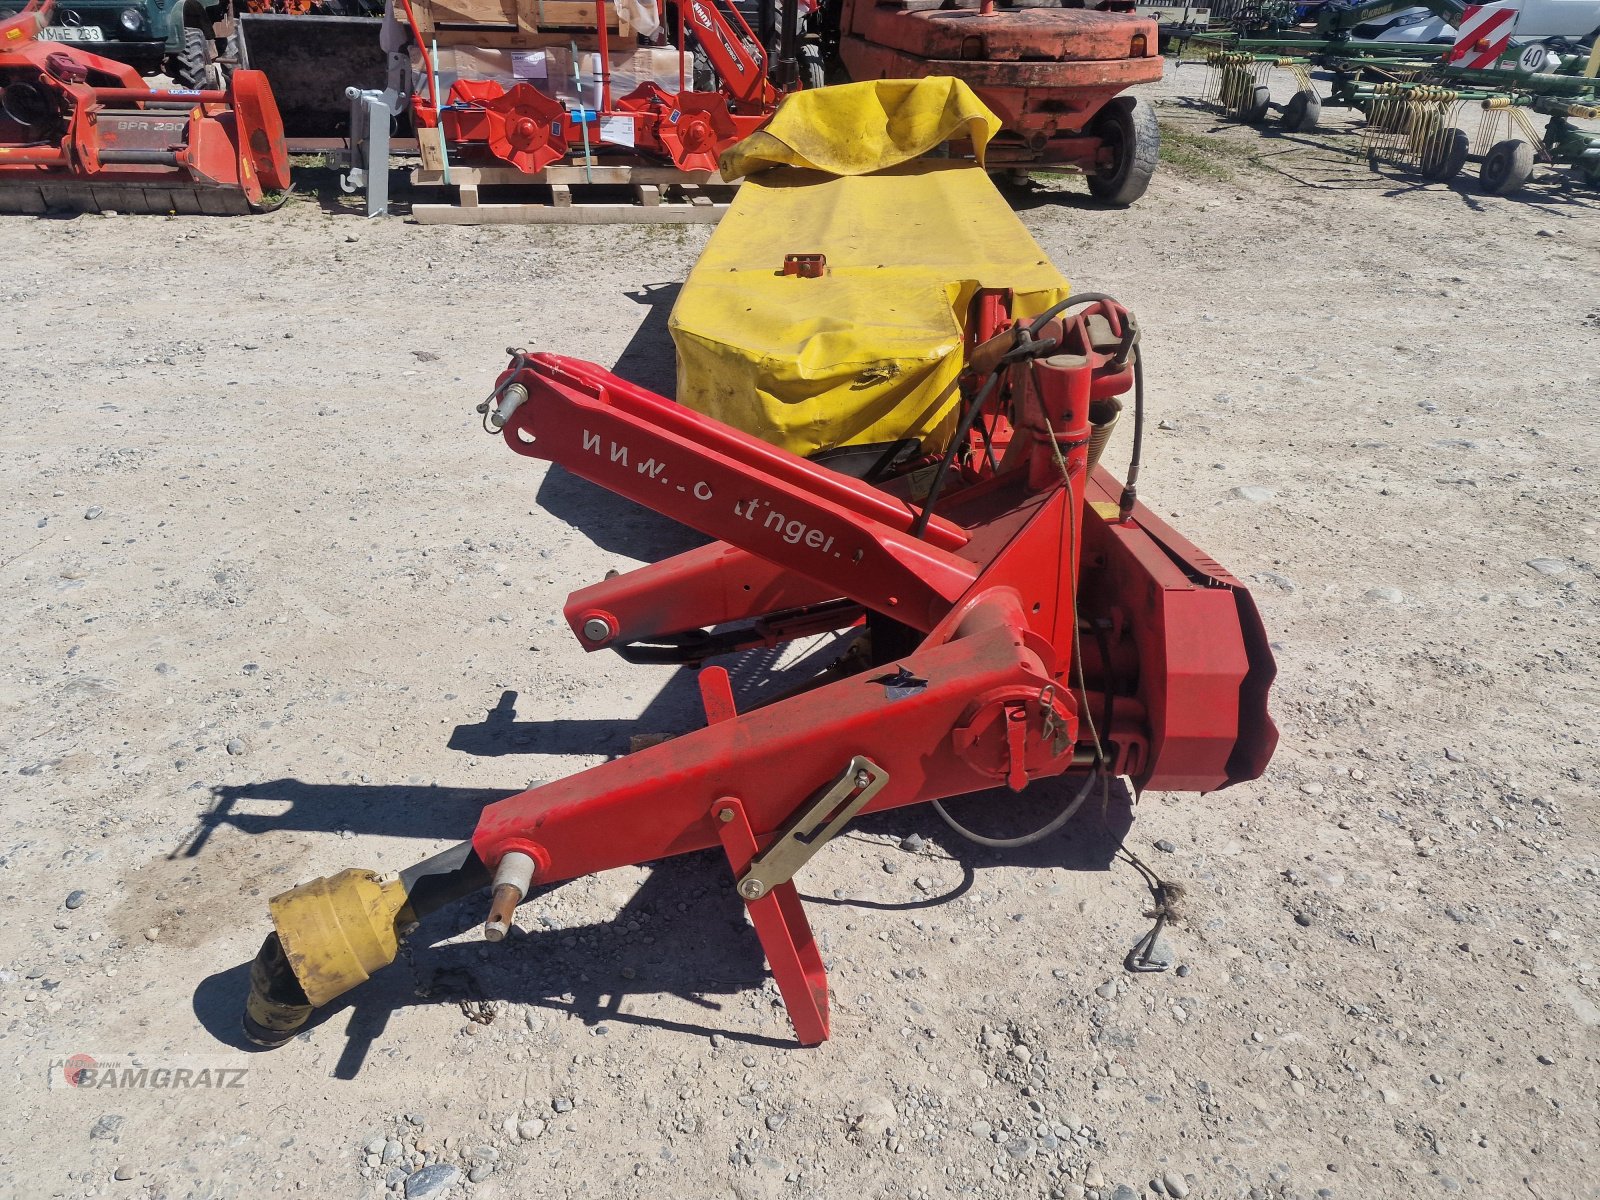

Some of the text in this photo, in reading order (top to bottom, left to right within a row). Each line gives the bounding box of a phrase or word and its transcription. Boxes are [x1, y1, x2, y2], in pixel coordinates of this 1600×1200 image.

[693, 2, 711, 28] KUHN
[1523, 48, 1543, 68] 40
[153, 122, 184, 131] 280
